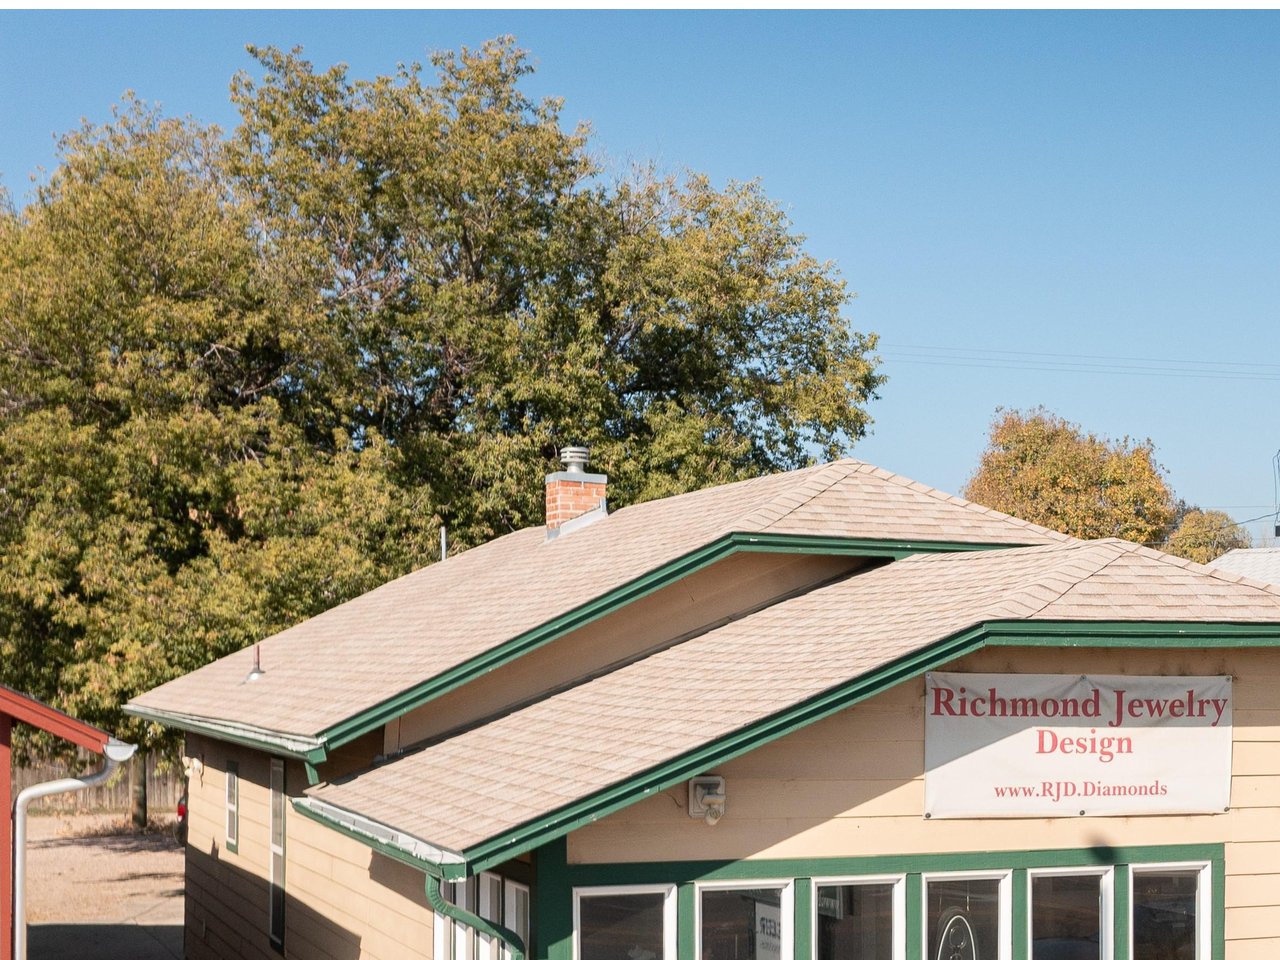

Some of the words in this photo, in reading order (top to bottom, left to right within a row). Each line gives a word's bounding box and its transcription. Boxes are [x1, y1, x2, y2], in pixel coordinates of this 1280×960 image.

[930, 687, 1102, 718] Richmond
[1108, 689, 1228, 727] Jewelry
[1036, 728, 1133, 762] Design
[994, 780, 1168, 802] www.RJD.Diamonds
